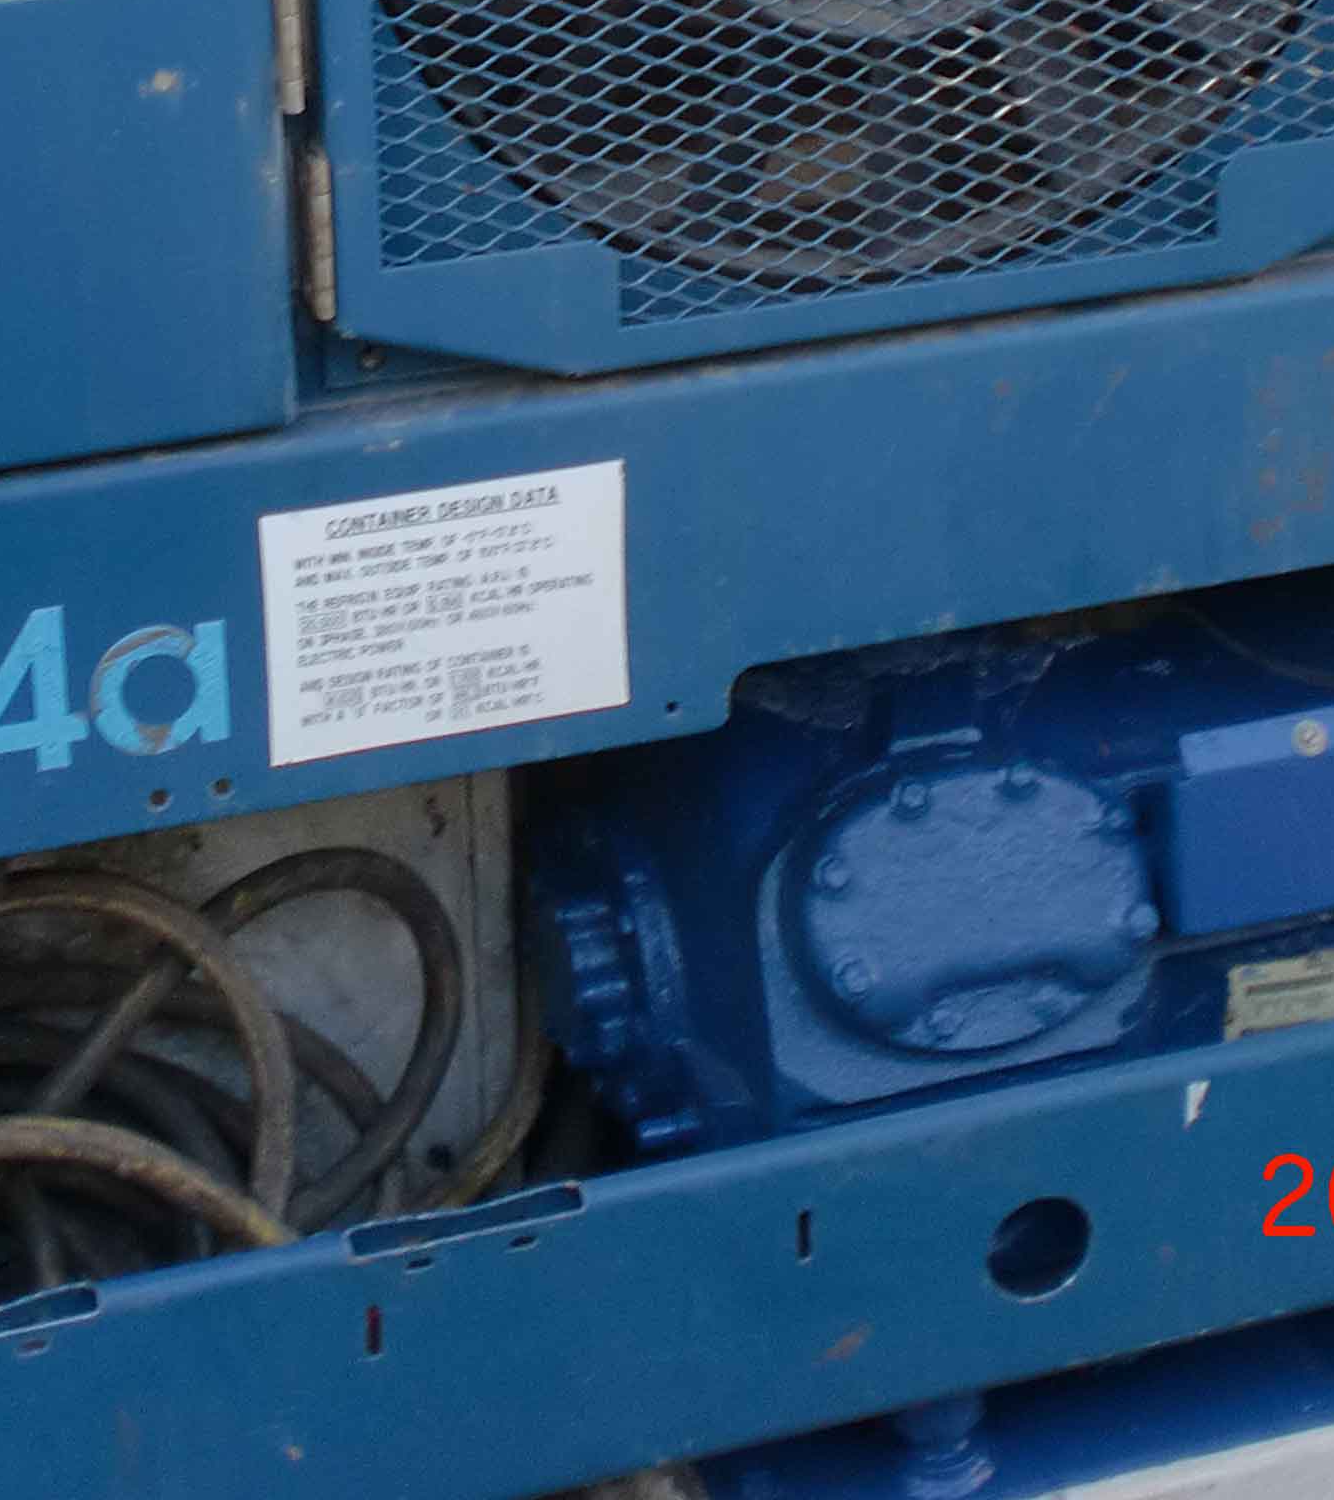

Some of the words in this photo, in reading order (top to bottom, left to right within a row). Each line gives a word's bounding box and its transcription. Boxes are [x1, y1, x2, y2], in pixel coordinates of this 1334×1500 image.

[324, 504, 429, 537] CONTAINER
[437, 495, 503, 520] DESIGN
[507, 486, 559, 509] DATA
